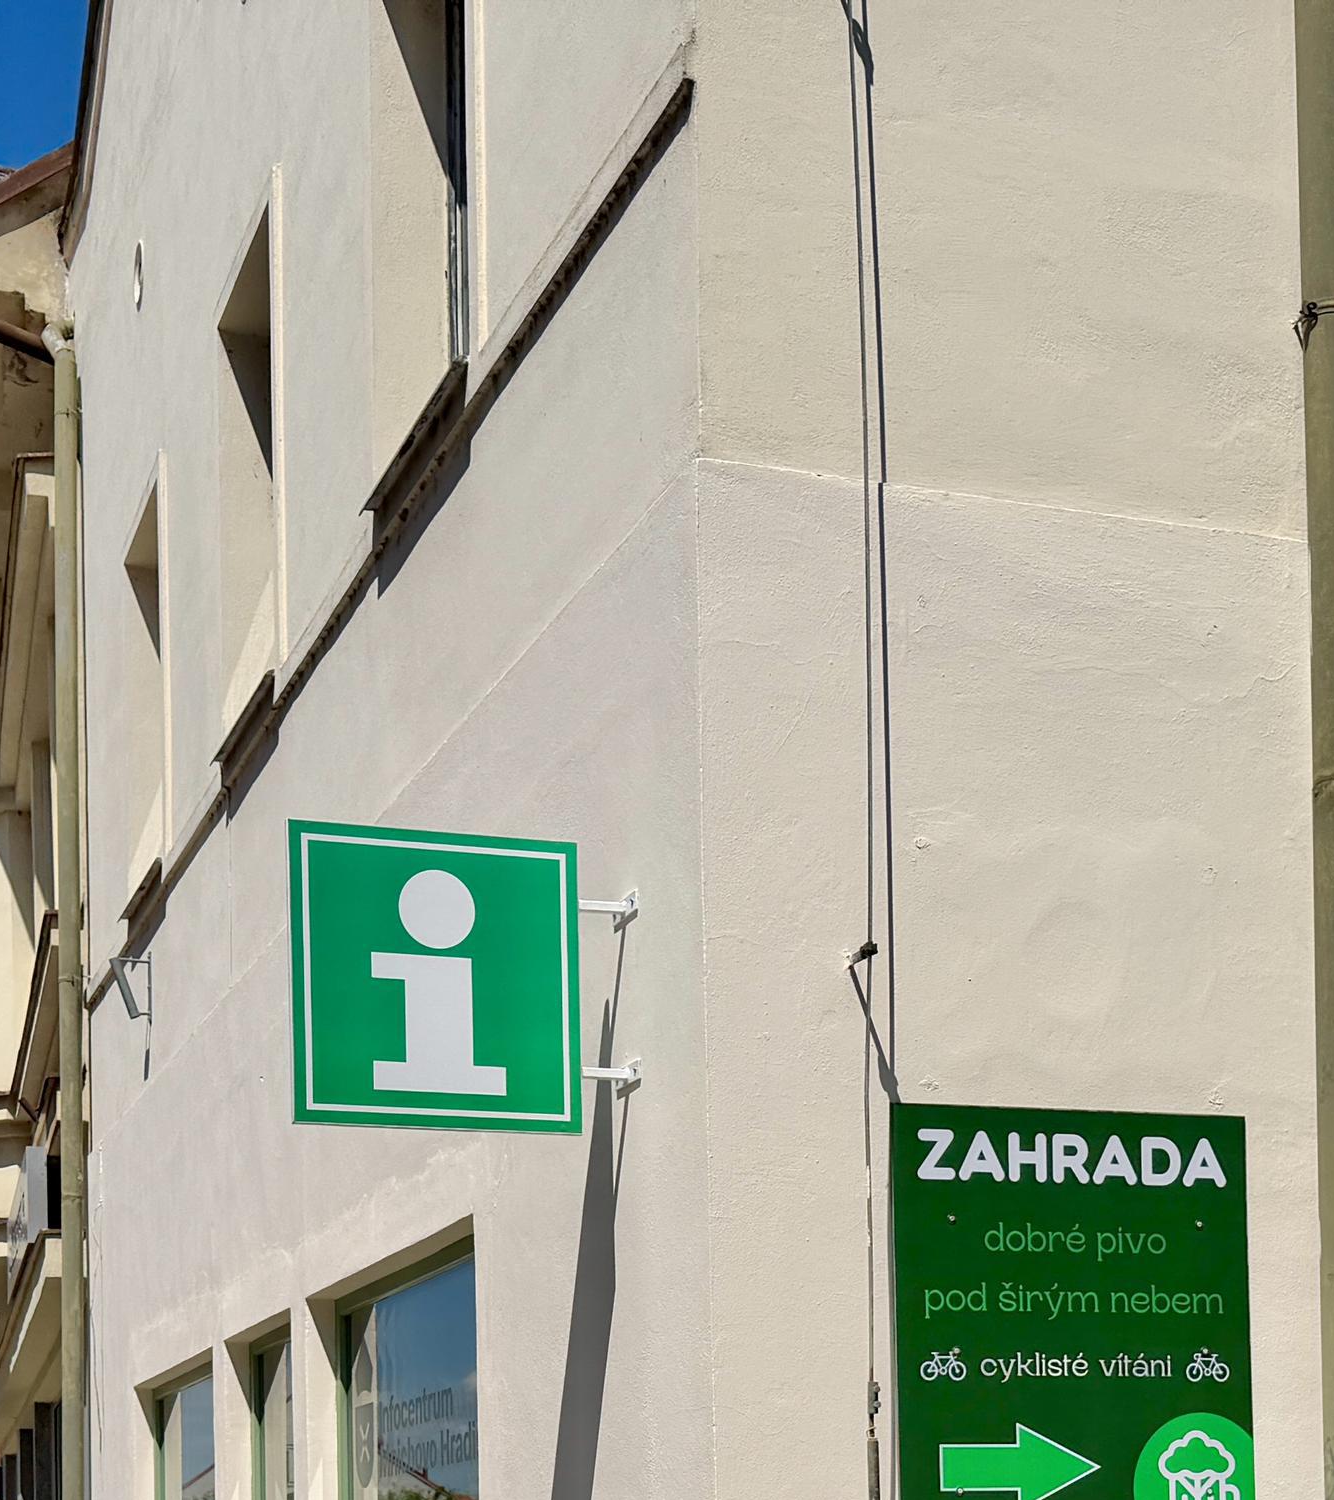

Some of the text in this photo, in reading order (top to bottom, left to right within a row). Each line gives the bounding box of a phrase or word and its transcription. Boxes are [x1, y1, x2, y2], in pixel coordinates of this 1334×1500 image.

[917, 1128, 1227, 1188] ZAHRADA
[984, 1222, 1167, 1261] dobré pivo
[924, 1281, 1224, 1320] pod širým nebem
[980, 1352, 1172, 1383] cyklisté vítáni
[379, 1387, 453, 1433] Infocentrum
[441, 1420, 478, 1466] Hradi
